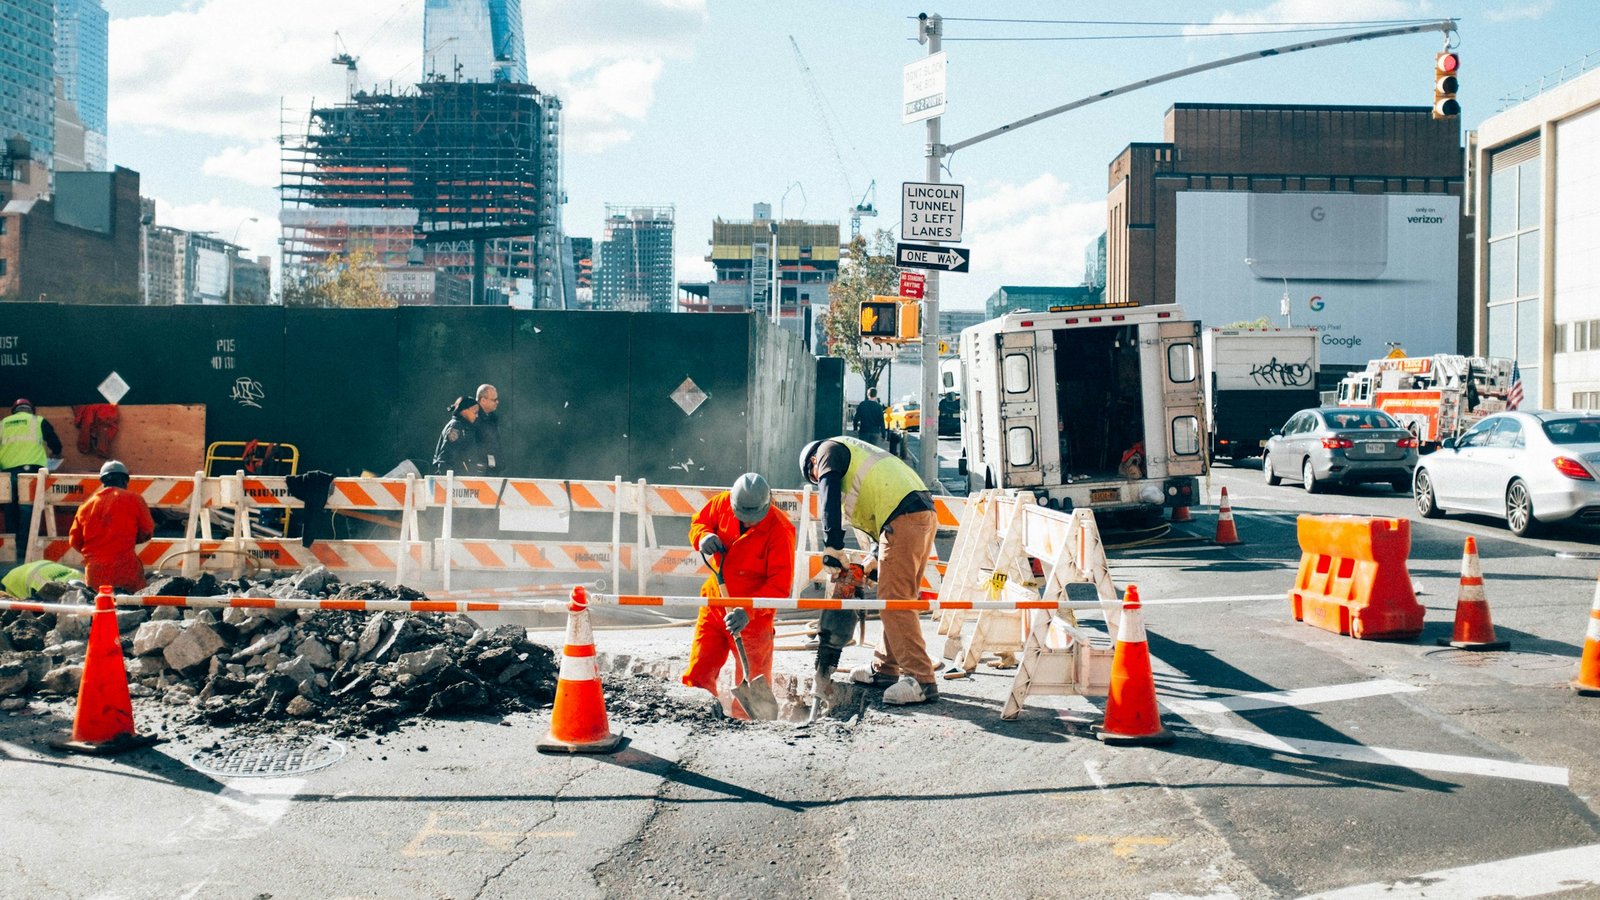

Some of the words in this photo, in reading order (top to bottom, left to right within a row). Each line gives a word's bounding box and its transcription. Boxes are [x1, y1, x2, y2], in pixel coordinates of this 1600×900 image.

[908, 187, 959, 199] LINCOLN
[909, 200, 957, 212] TUNNEL
[911, 213, 918, 222] 3
[925, 213, 954, 224] LEFT
[1407, 214, 1443, 224] verizon
[912, 226, 952, 237] LANES
[907, 251, 928, 262] ONE
[937, 253, 959, 265] WAY
[1309, 296, 1325, 312] G
[1321, 334, 1362, 349] Google
[52, 484, 85, 495] TRIUMPH
